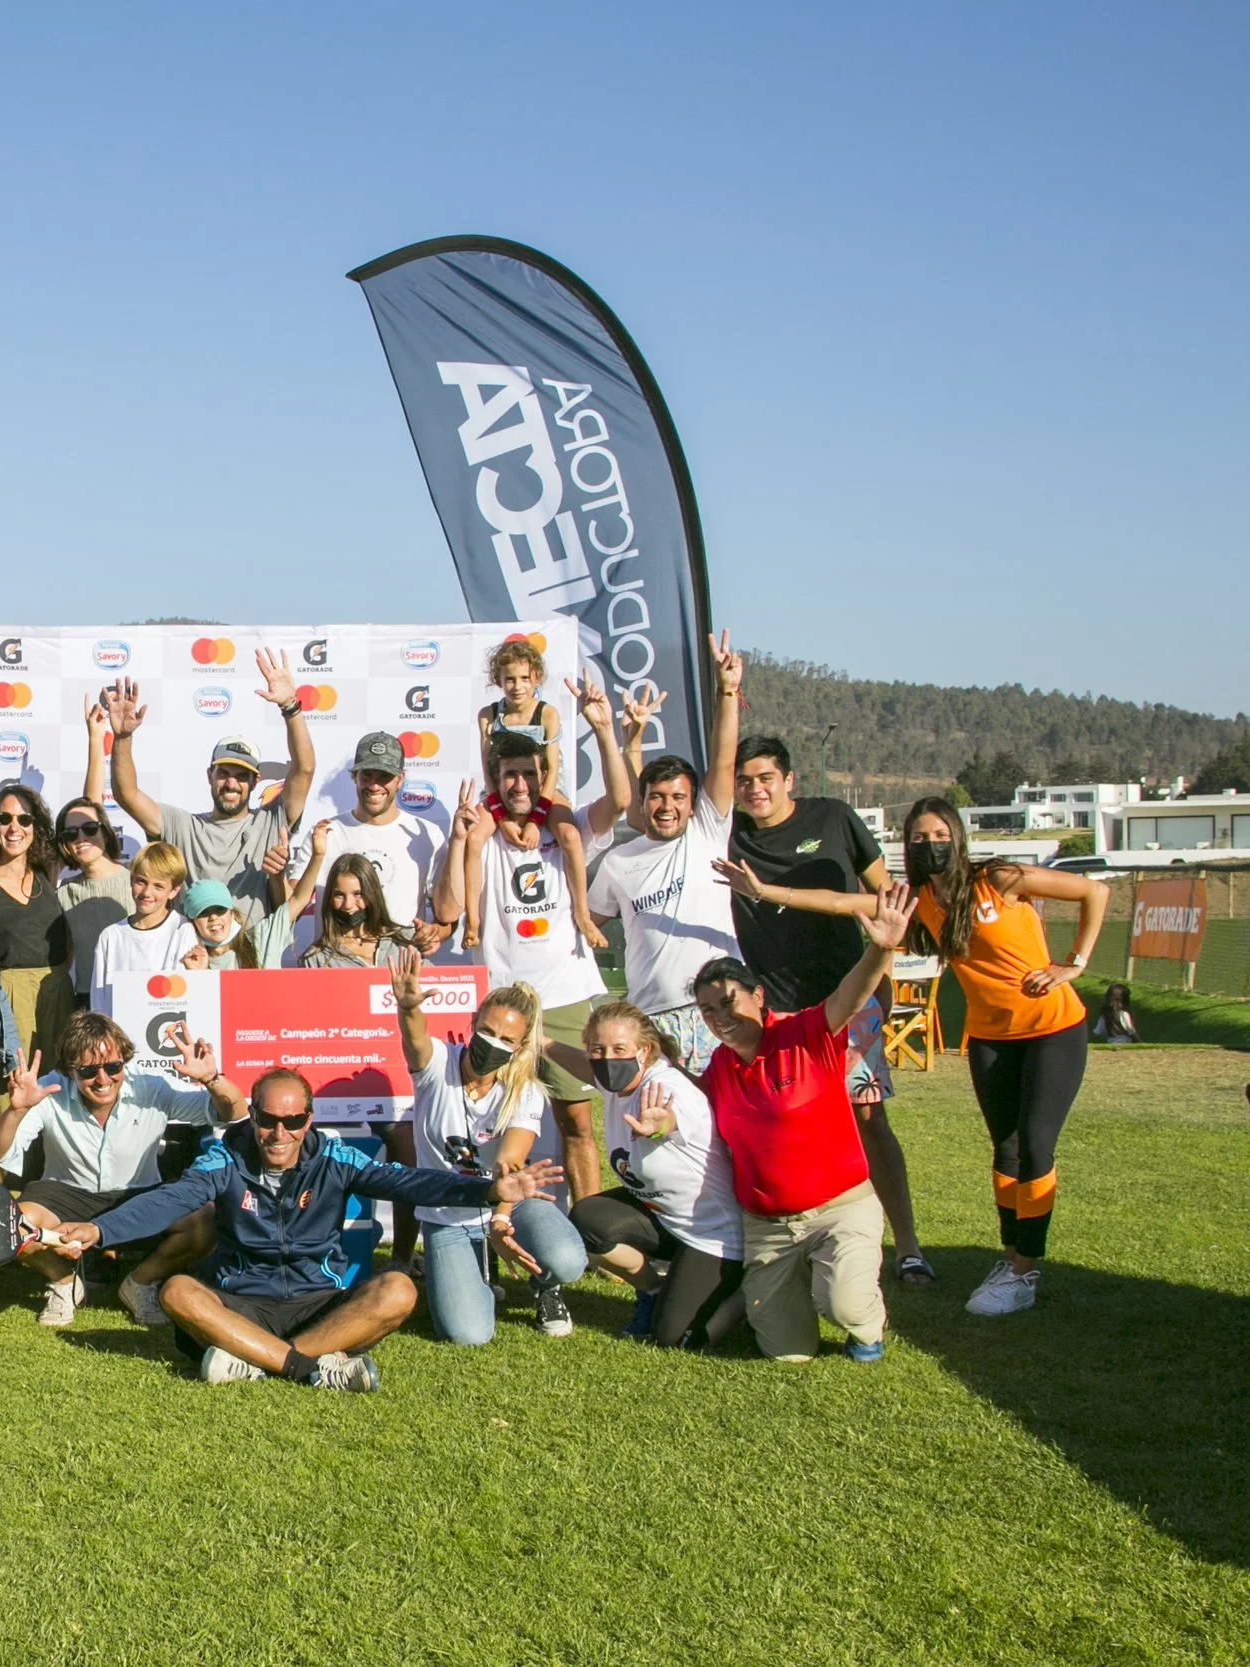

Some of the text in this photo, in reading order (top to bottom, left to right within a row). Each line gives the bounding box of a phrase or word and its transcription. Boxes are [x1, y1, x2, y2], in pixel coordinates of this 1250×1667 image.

[97, 652, 127, 662] Savory
[405, 651, 436, 662] Savory
[197, 699, 228, 709] Savory
[402, 792, 434, 803] Savory
[504, 902, 558, 915] GATORADE
[1145, 906, 1202, 934] GATORADE
[280, 1028, 326, 1039] Campeón
[281, 1054, 313, 1064] Ciento
[314, 1055, 361, 1064] cincuenta
